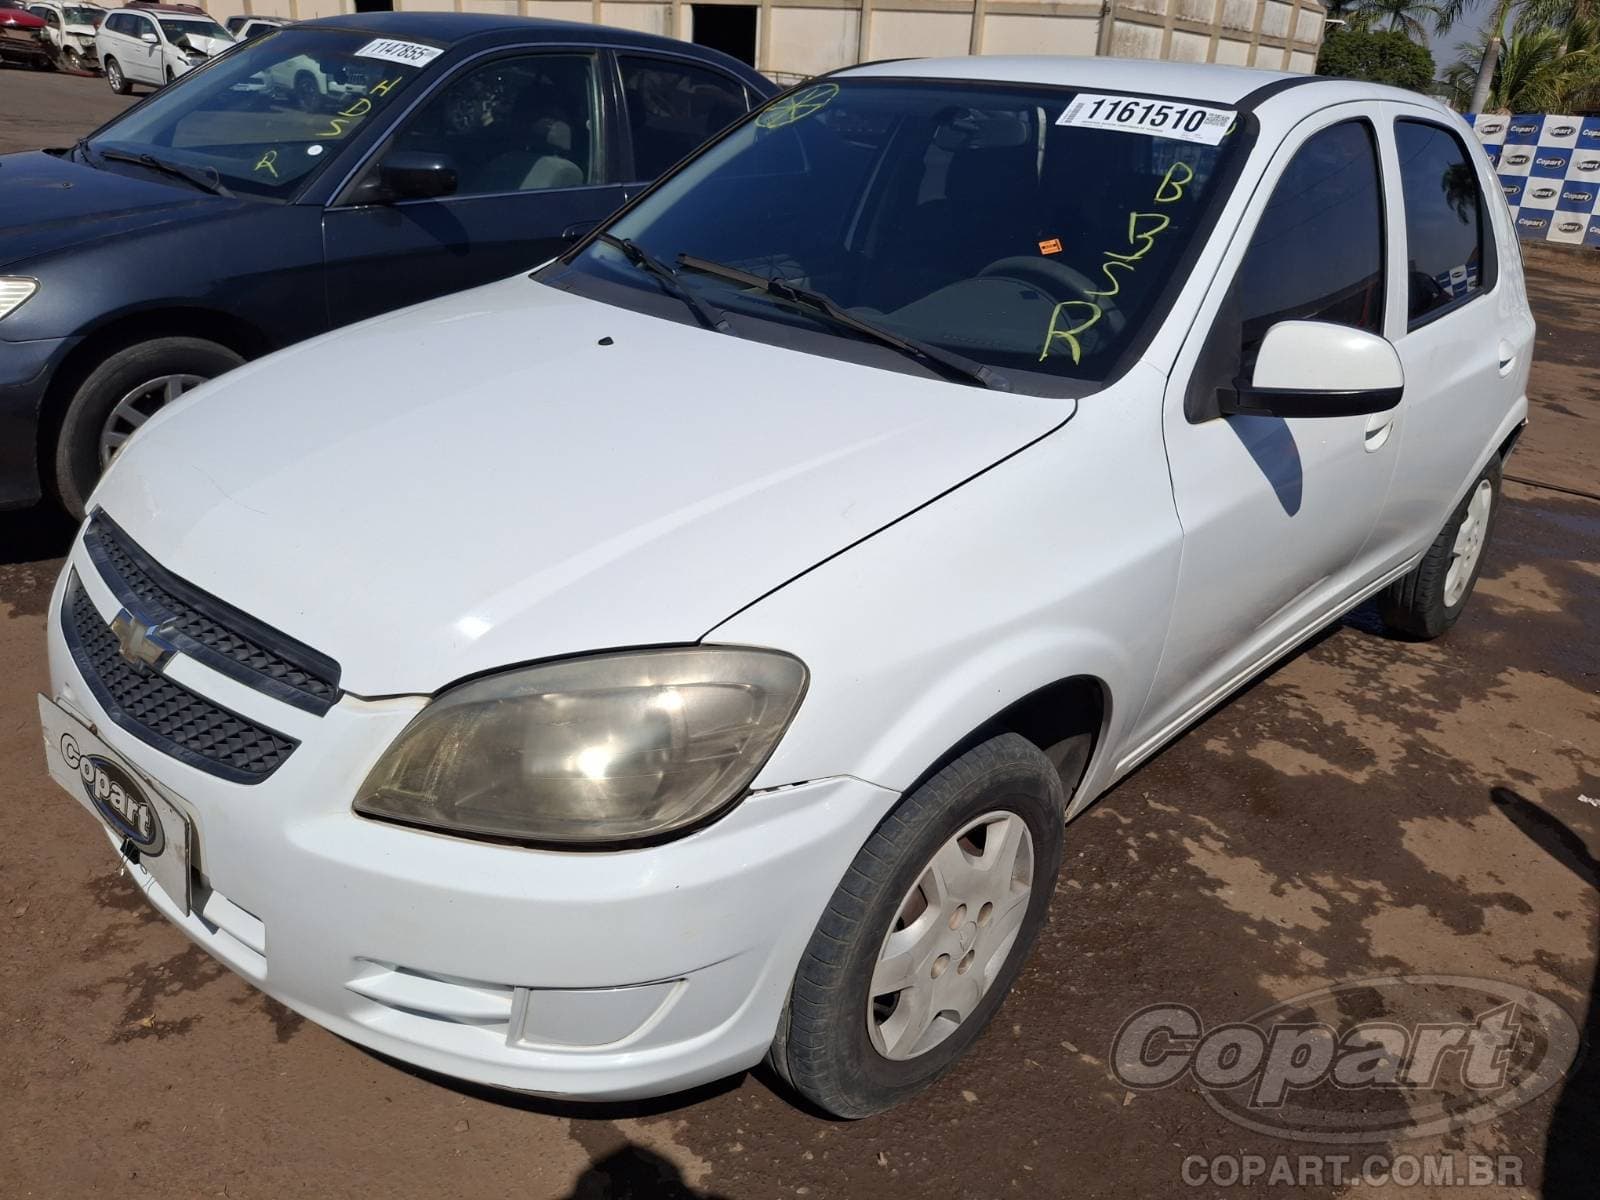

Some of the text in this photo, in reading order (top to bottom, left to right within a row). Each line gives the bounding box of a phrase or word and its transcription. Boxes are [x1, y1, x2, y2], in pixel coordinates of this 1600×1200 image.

[370, 41, 430, 60] 1147855
[1088, 99, 1207, 133] 1161510
[1475, 123, 1600, 138] opart Copart opart Copa
[1536, 158, 1562, 168] Copart
[1573, 160, 1600, 171] opart
[1563, 192, 1589, 201] Copart
[1519, 219, 1543, 228] Copart
[1556, 223, 1580, 232] opart
[61, 733, 154, 840] Copart
